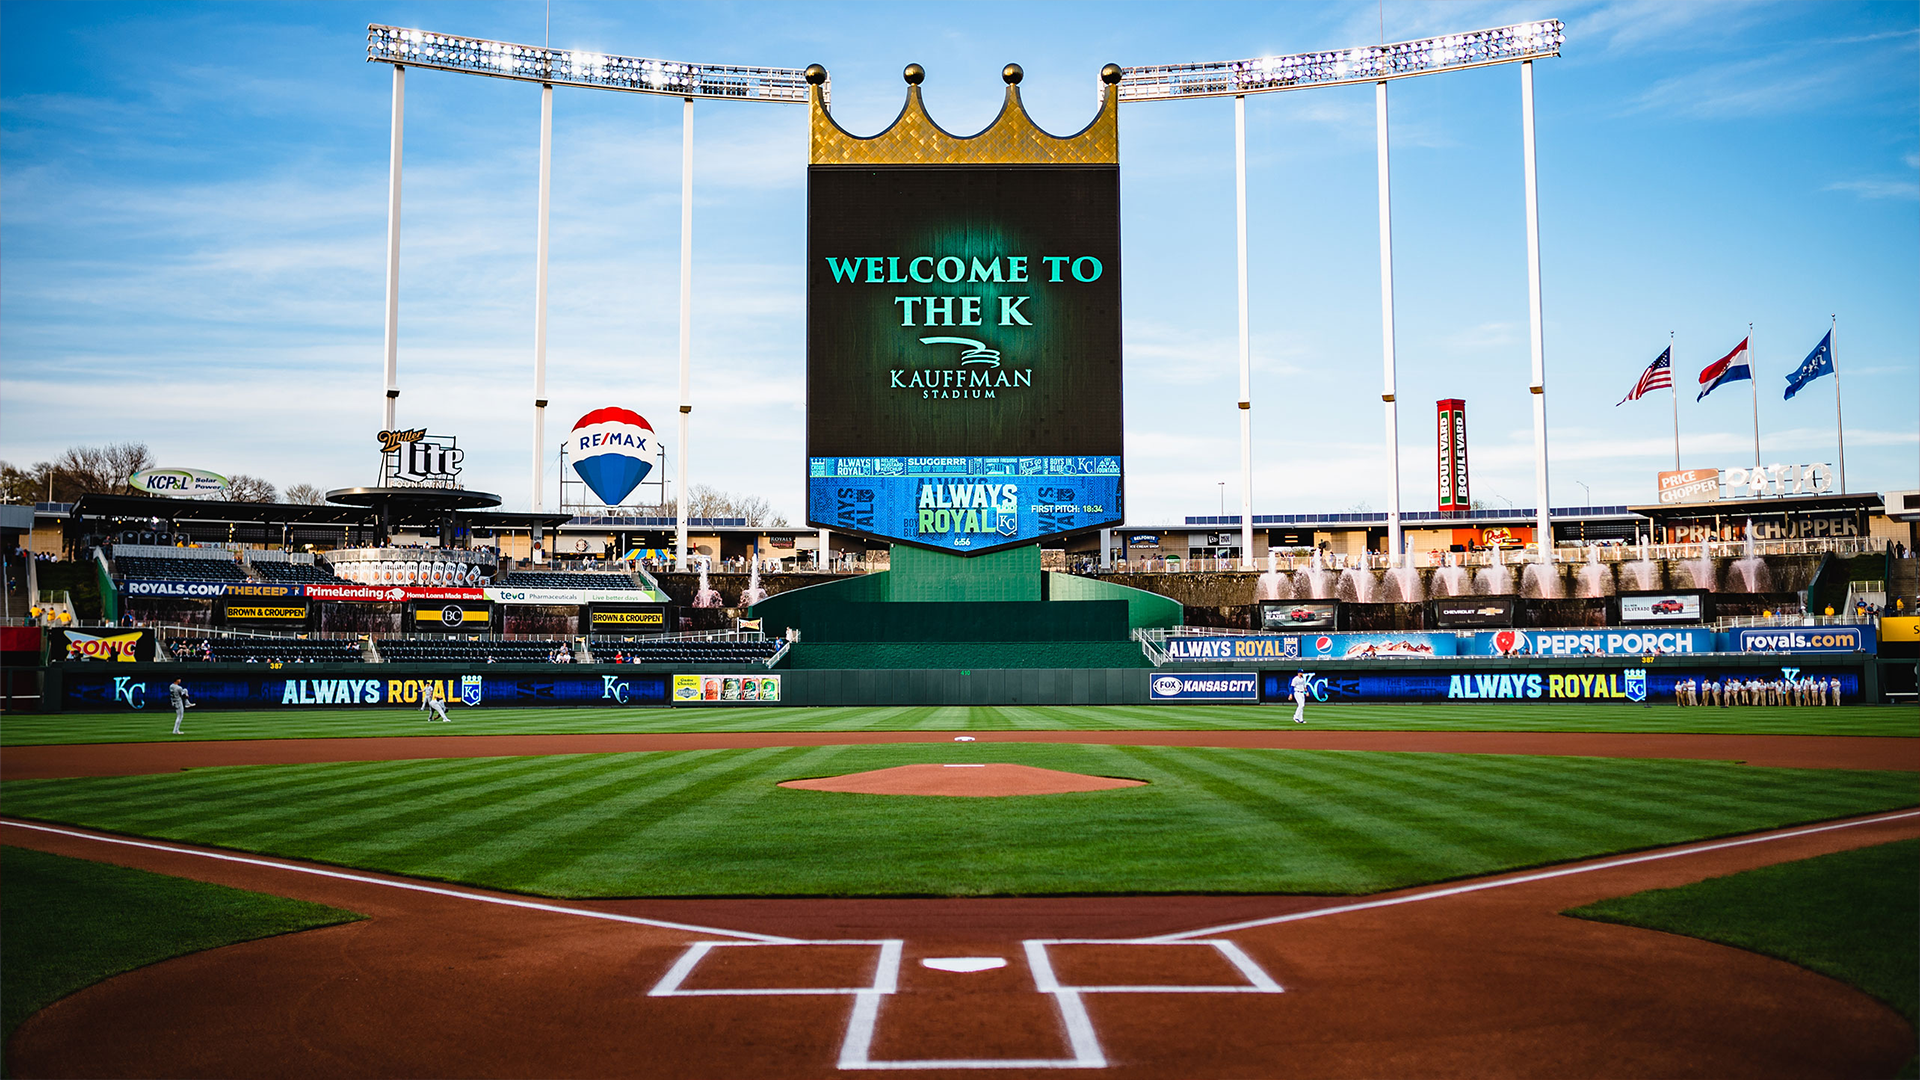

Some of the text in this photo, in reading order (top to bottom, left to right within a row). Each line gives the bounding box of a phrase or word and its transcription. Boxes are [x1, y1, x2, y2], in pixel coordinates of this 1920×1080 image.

[825, 256, 1104, 284] WELCOME TO
[894, 296, 1033, 327] THE K
[890, 368, 1033, 389] KAUFFMAN
[922, 389, 996, 399] STADIUM
[379, 430, 425, 449] Miller
[579, 432, 647, 451] RE/MAX
[394, 440, 464, 482] Lite
[838, 458, 871, 467] ALWAYS
[1078, 458, 1093, 473] KC
[1440, 417, 1451, 497] BOULEVARD
[1456, 417, 1468, 497] BOULEVARD
[838, 467, 863, 475] ROYAL
[1662, 471, 1697, 488] PRICE
[146, 476, 189, 490] KCP&L
[1725, 463, 1832, 498] PATIO
[918, 484, 1017, 508] ALWAYS
[1661, 480, 1718, 500] CHOPPER
[1031, 505, 1103, 513] FIRST PITCH: 18:34
[918, 509, 997, 533] ROYAL
[999, 515, 1015, 530] KC
[954, 538, 970, 546] 6:56
[306, 587, 384, 600] PrimeLending
[500, 591, 524, 600] teva
[228, 608, 304, 618] BROWN & CROUPPEN
[444, 610, 461, 621] BC
[593, 614, 660, 622] BROWN & CROUPPEN
[71, 640, 136, 656] SONIC
[1169, 641, 1284, 657] ALWAYS ROYAL
[1286, 645, 1296, 654] KC
[1537, 633, 1693, 654] PEPSI PORCH
[1746, 632, 1854, 650] royals.com
[113, 676, 146, 709] KC
[282, 680, 462, 704] ALWAYS ROYAL
[465, 686, 480, 700] KC
[602, 675, 629, 704] KC
[1184, 680, 1228, 692] KANSAS
[1302, 673, 1328, 702] KC
[1448, 674, 1625, 698] ALWAYS ROYAL
[1628, 681, 1644, 696] KC
